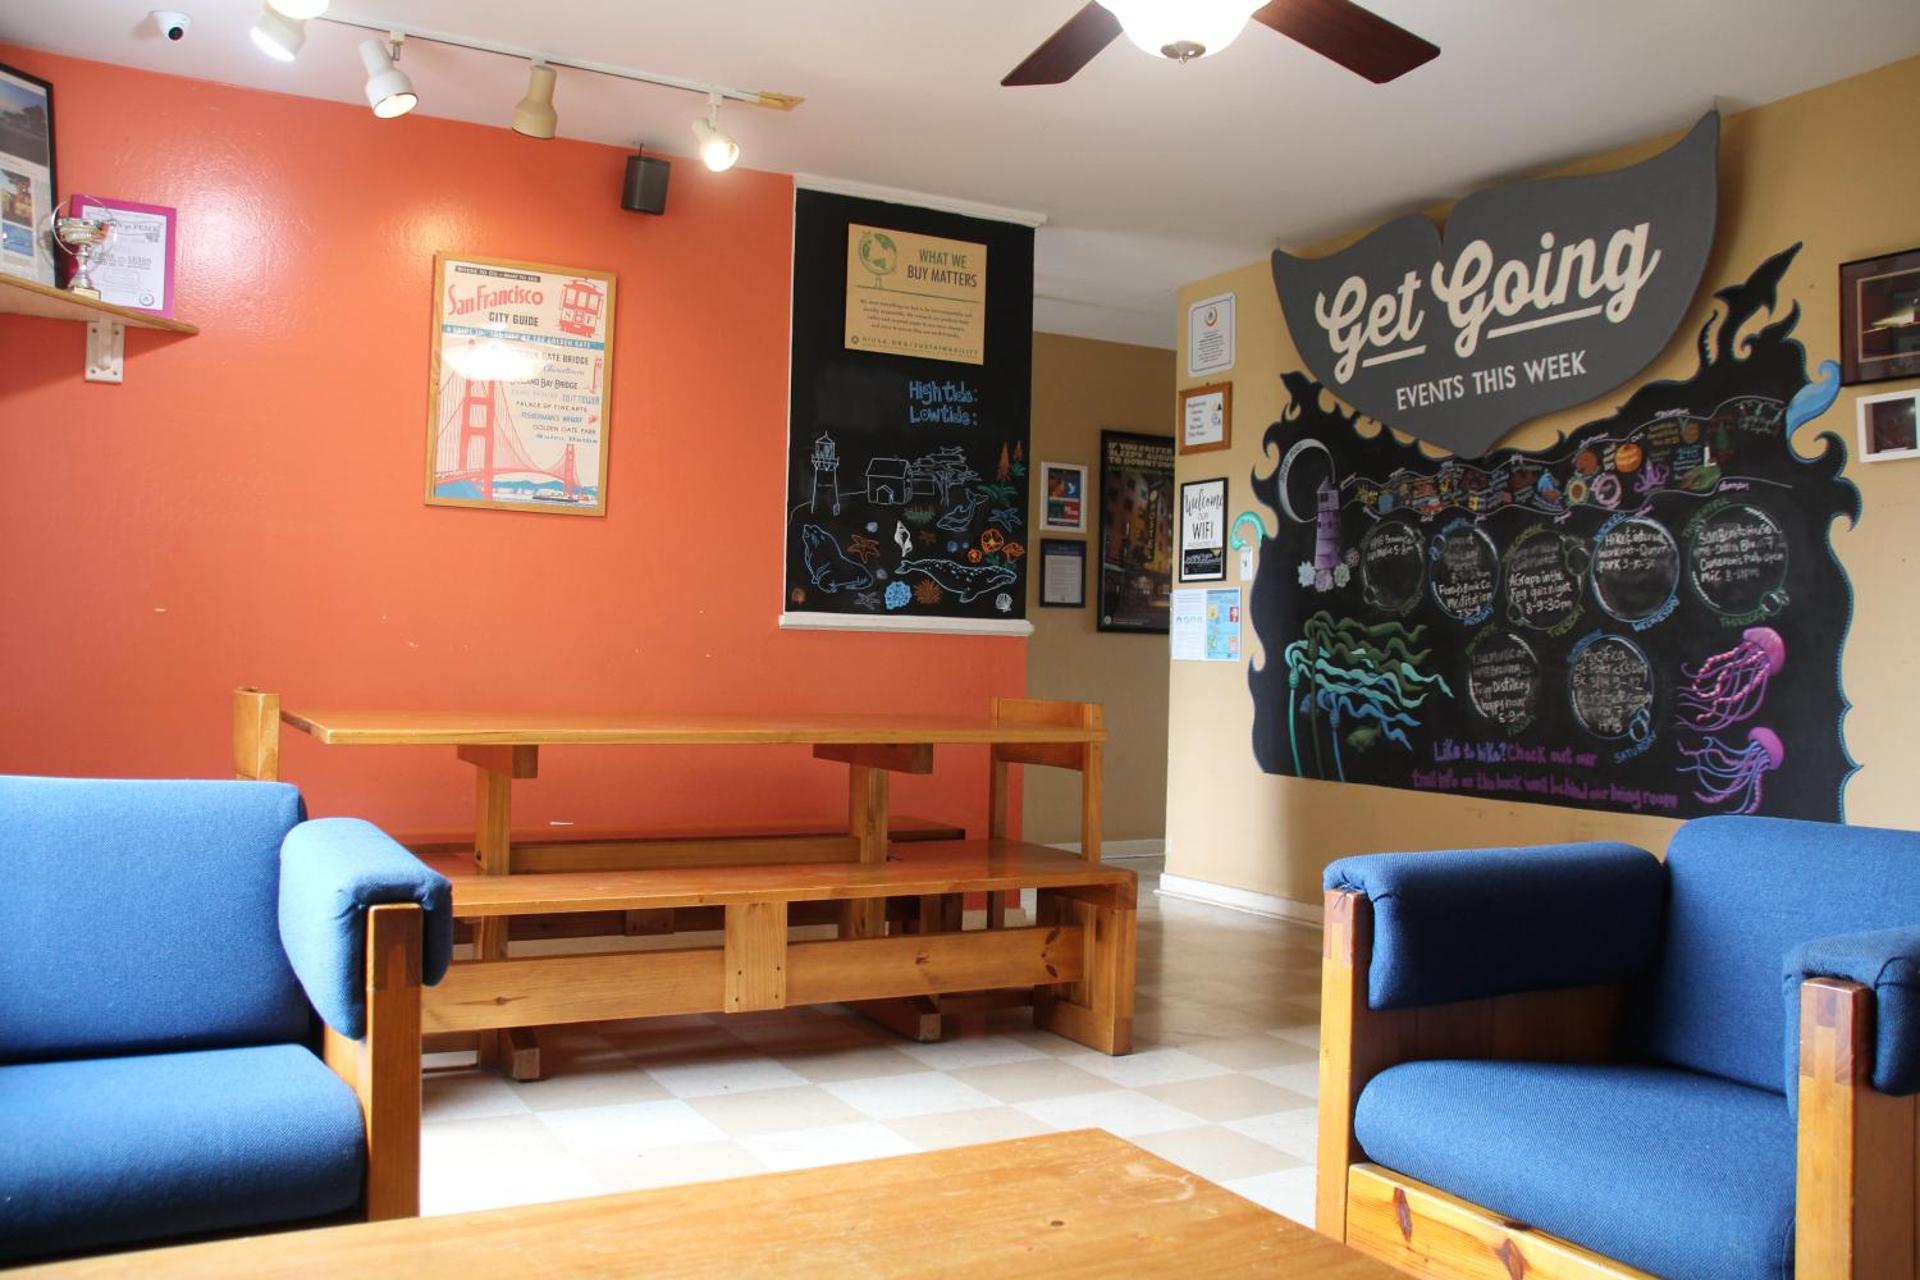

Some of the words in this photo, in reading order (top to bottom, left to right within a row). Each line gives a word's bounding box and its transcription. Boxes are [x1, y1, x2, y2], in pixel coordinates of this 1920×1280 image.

[919, 248, 947, 265] WHAT
[952, 253, 968, 268] WE
[907, 264, 929, 280] BUY
[931, 269, 978, 288] MATTERS
[447, 284, 474, 316] San
[476, 285, 544, 311] Francisco
[1315, 270, 1426, 385] Get
[1431, 223, 1662, 358] Going
[489, 312, 509, 324] CITY
[512, 314, 539, 327] GUIDE
[562, 355, 589, 365] BRIDGE
[1396, 374, 1465, 411] EVENTS
[1473, 363, 1516, 394] THIS
[1523, 350, 1587, 385] WEEK
[909, 380, 942, 405] High
[909, 405, 940, 424] Low
[1192, 521, 1214, 540] WIFI
